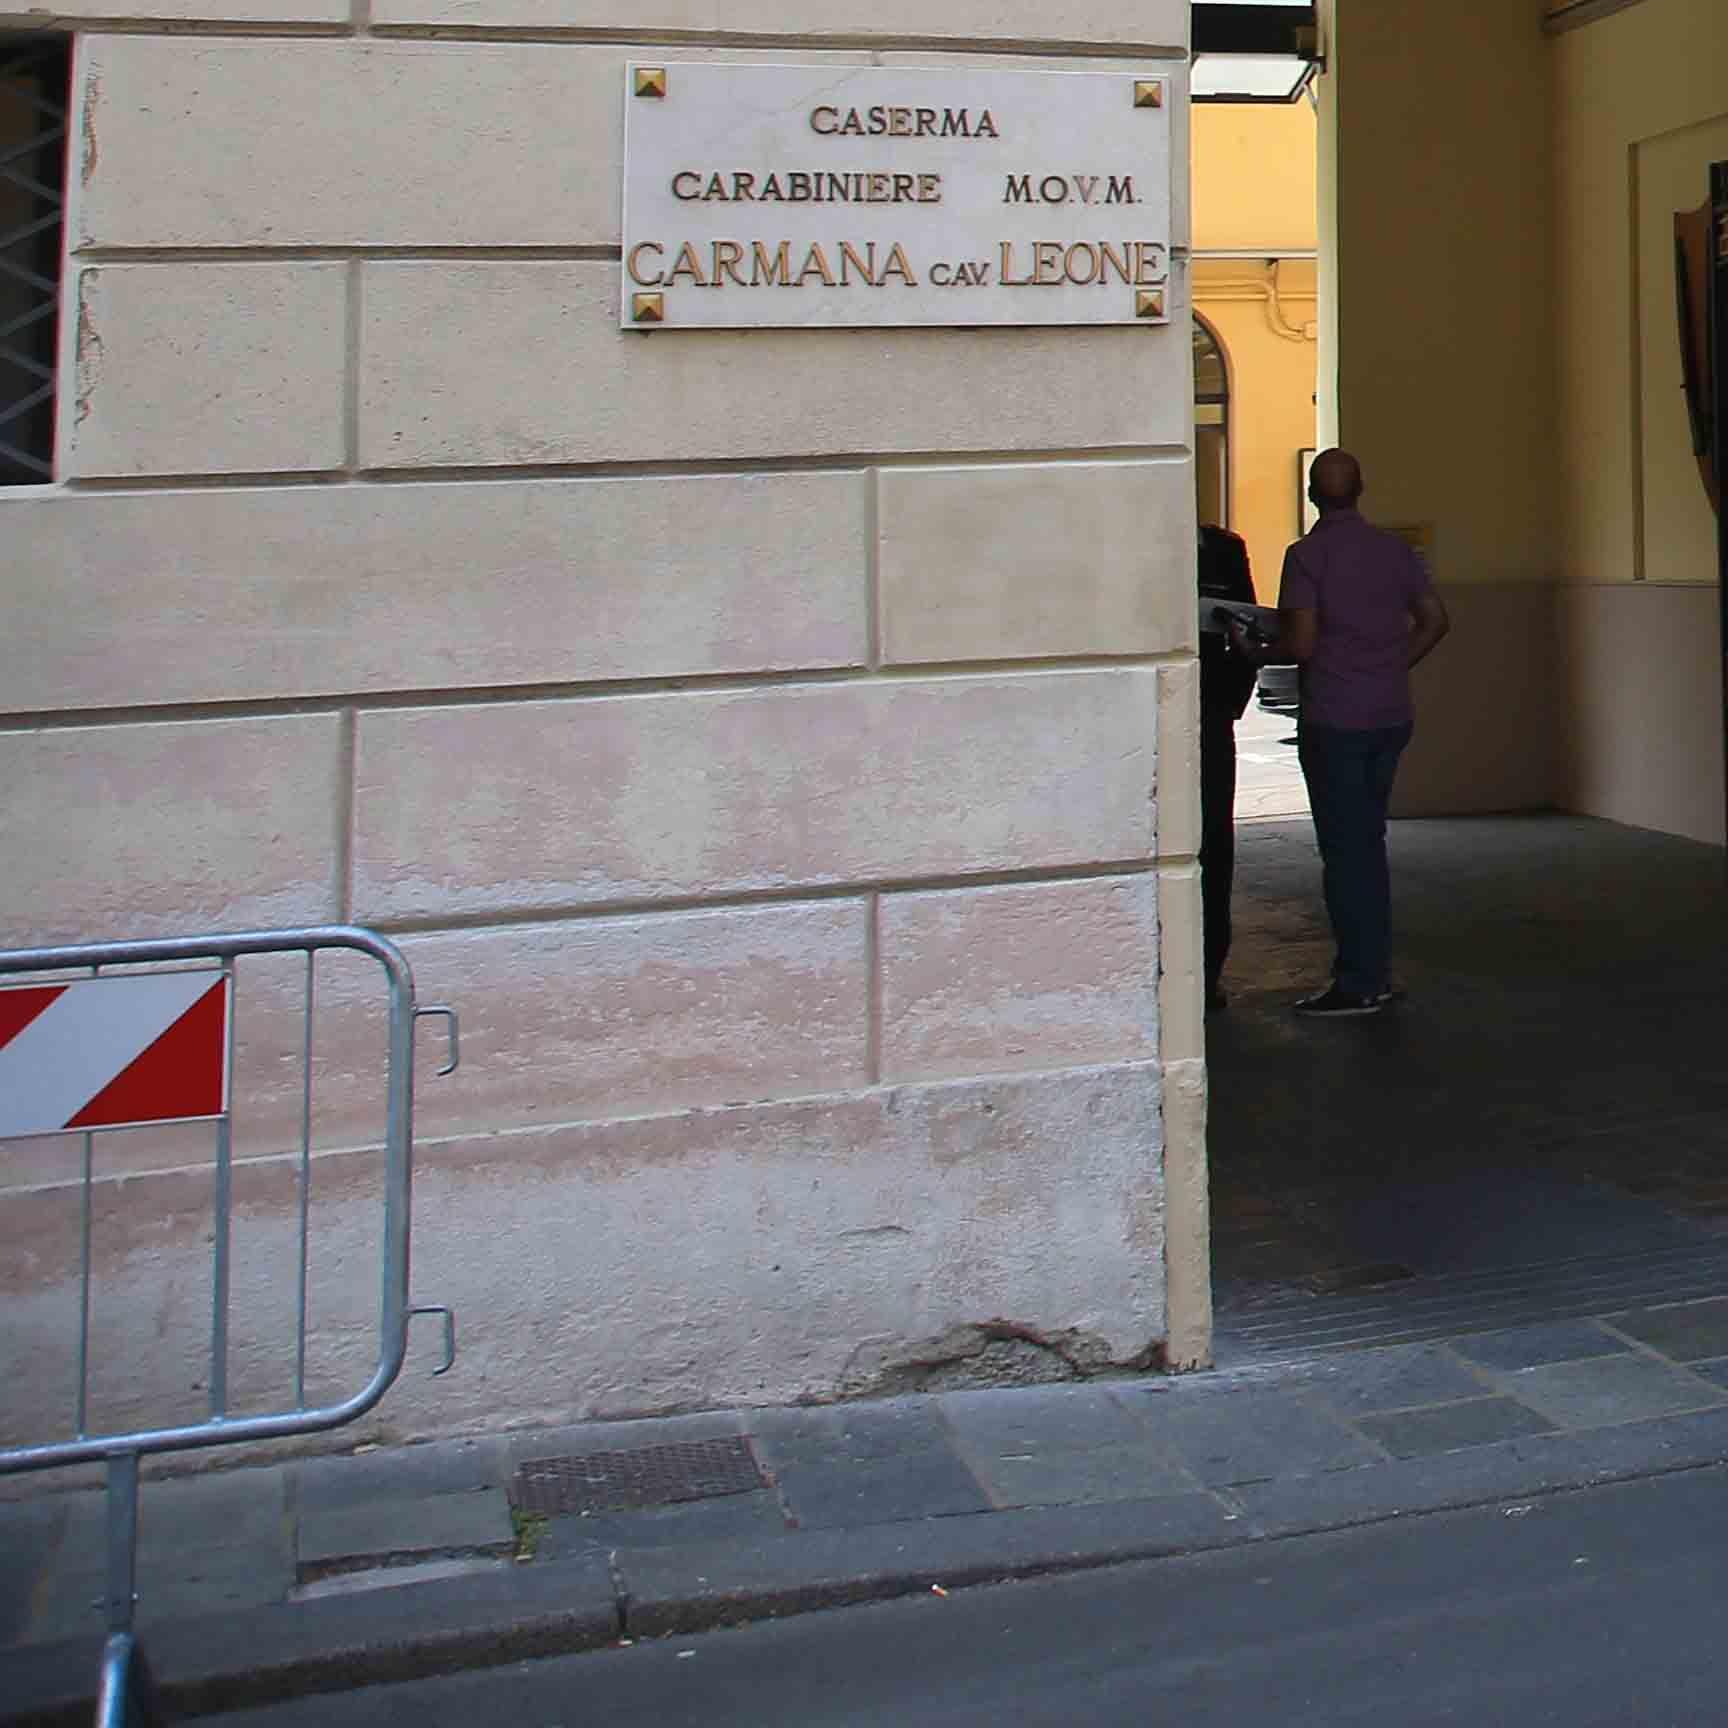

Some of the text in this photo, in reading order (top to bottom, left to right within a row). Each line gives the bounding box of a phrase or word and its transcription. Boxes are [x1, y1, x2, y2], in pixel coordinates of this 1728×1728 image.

[810, 106, 1000, 138] CASERMA
[671, 171, 943, 204] CARABINIERE
[626, 240, 918, 288] CARMANA
[997, 239, 1169, 288] LEONE
